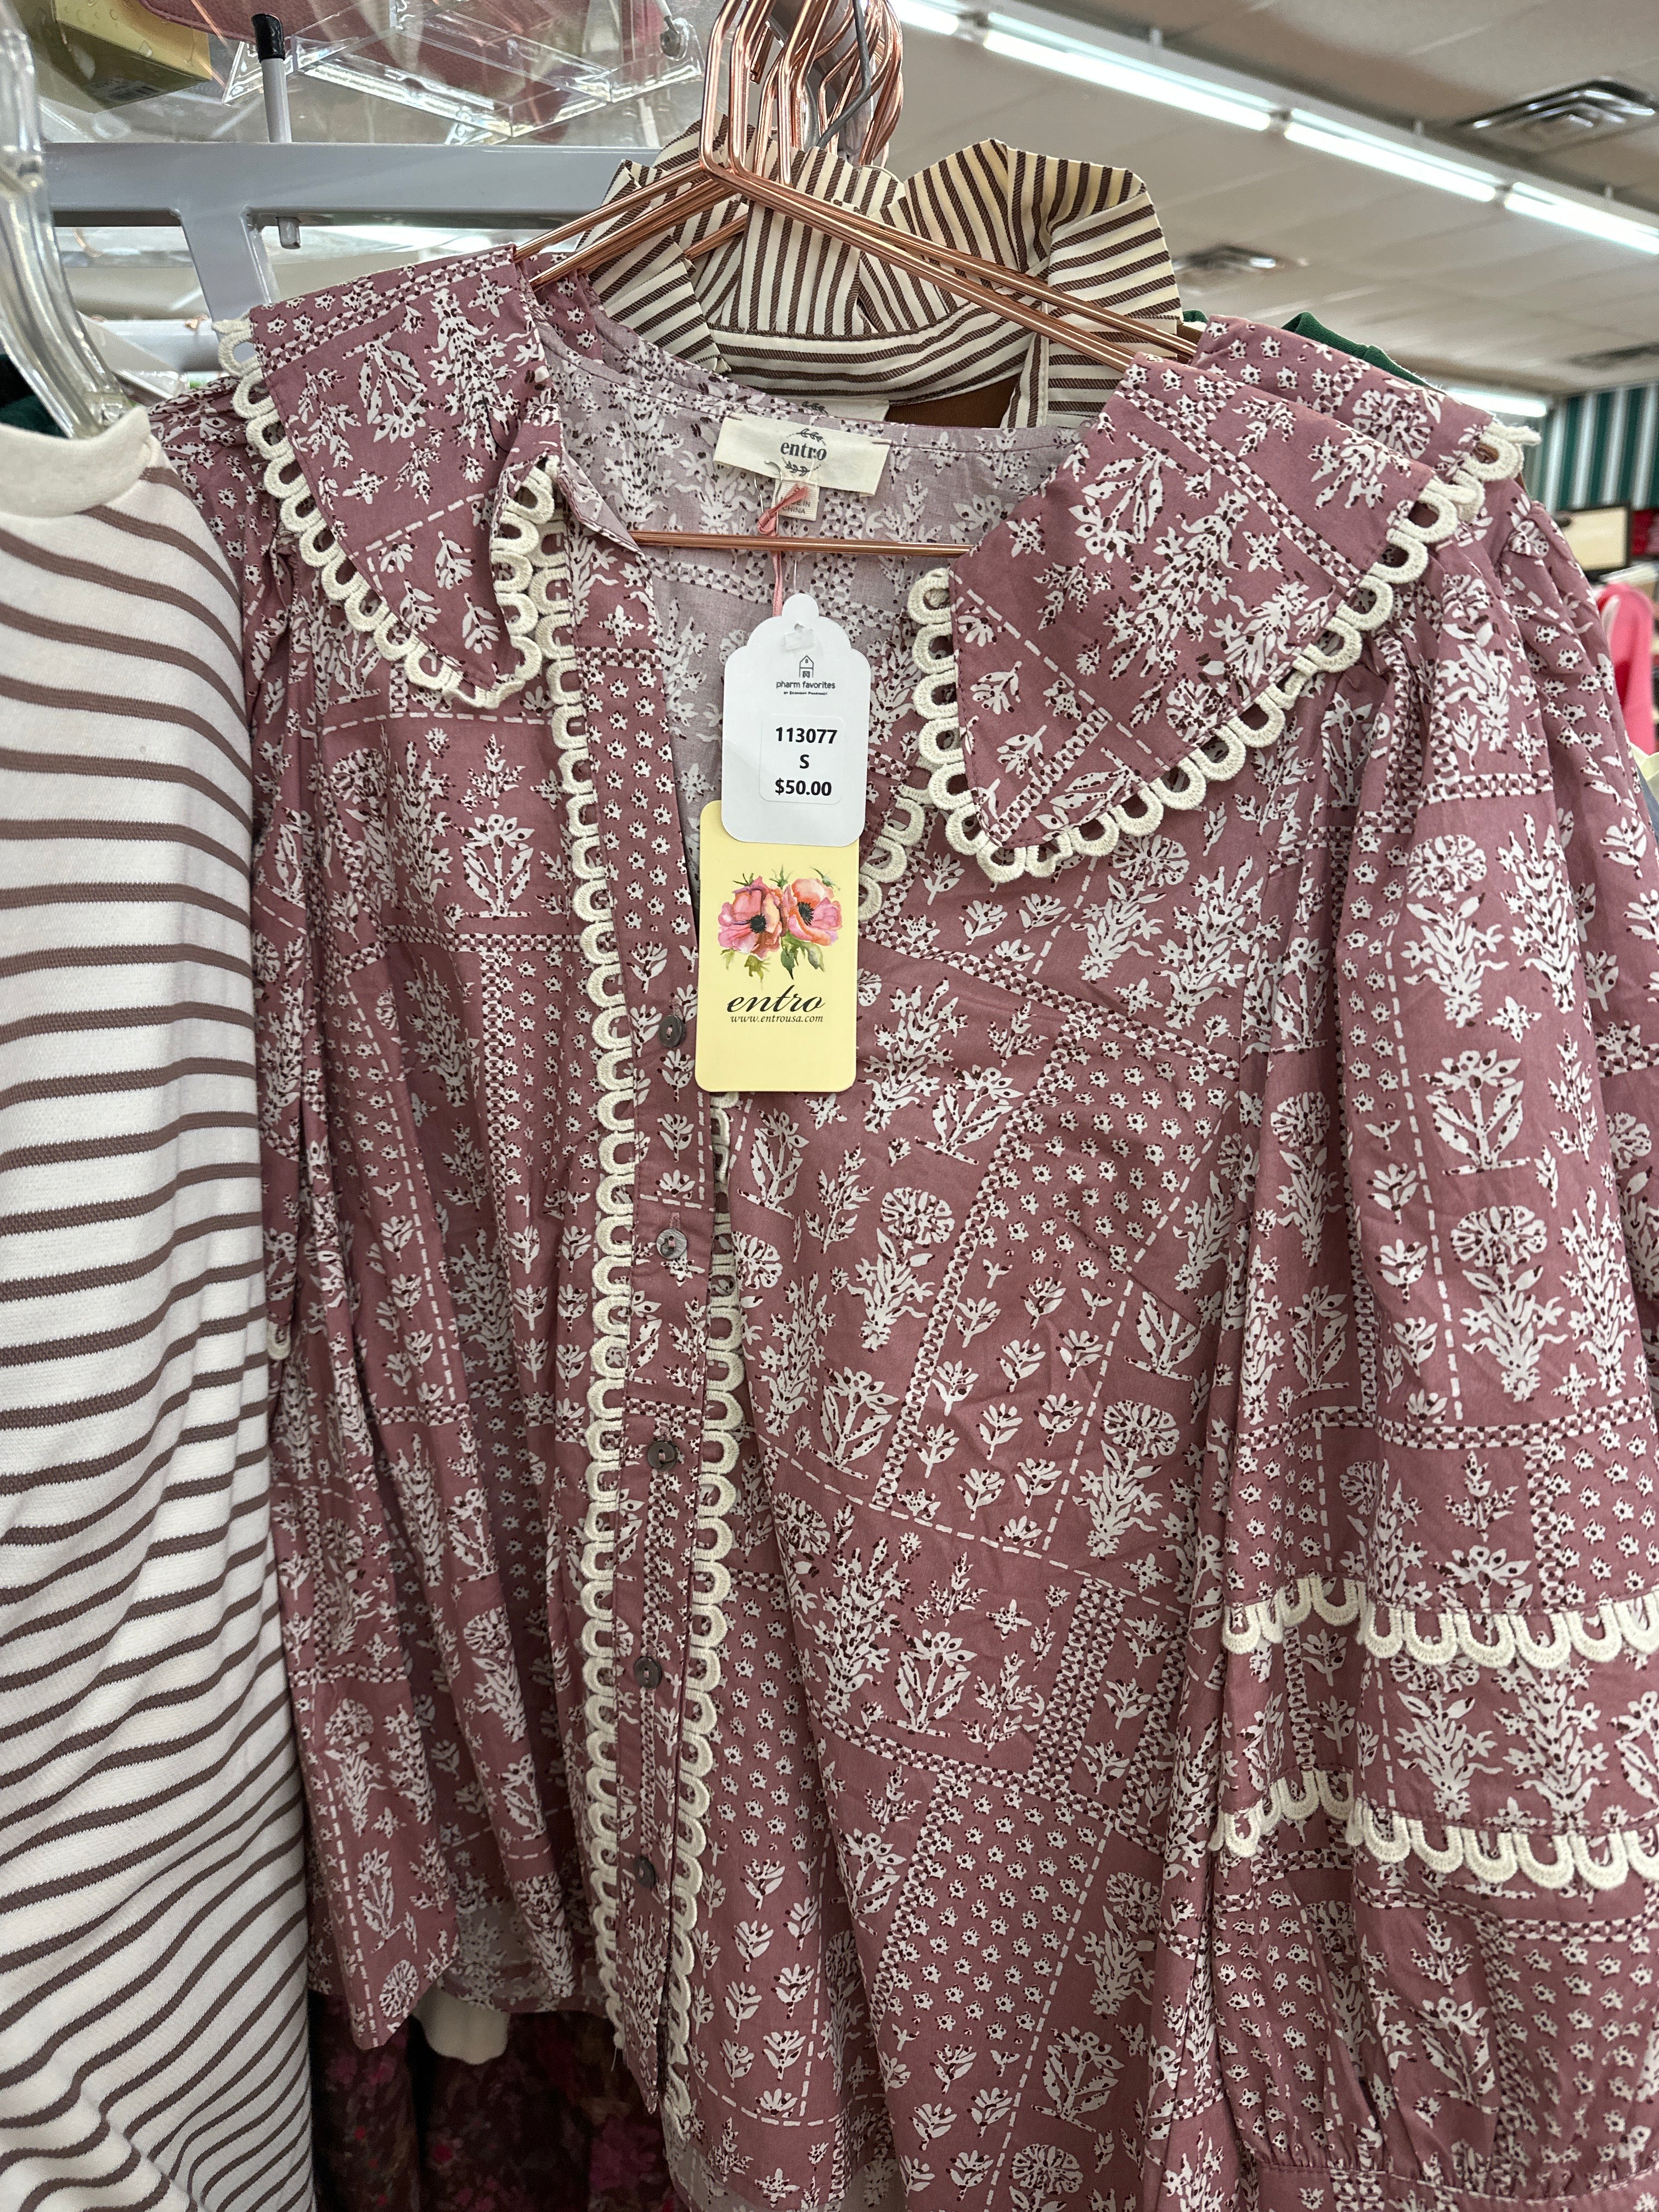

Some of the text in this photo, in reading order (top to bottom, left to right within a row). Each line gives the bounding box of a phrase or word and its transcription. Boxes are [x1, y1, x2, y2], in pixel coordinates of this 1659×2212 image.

[781, 442, 827, 460] entro
[782, 506, 805, 515] CHINA
[776, 680, 836, 689] pharm favorites
[776, 727, 838, 744] 113077
[799, 754, 810, 769] S
[775, 777, 832, 796] $50.00
[727, 984, 826, 1012] entro
